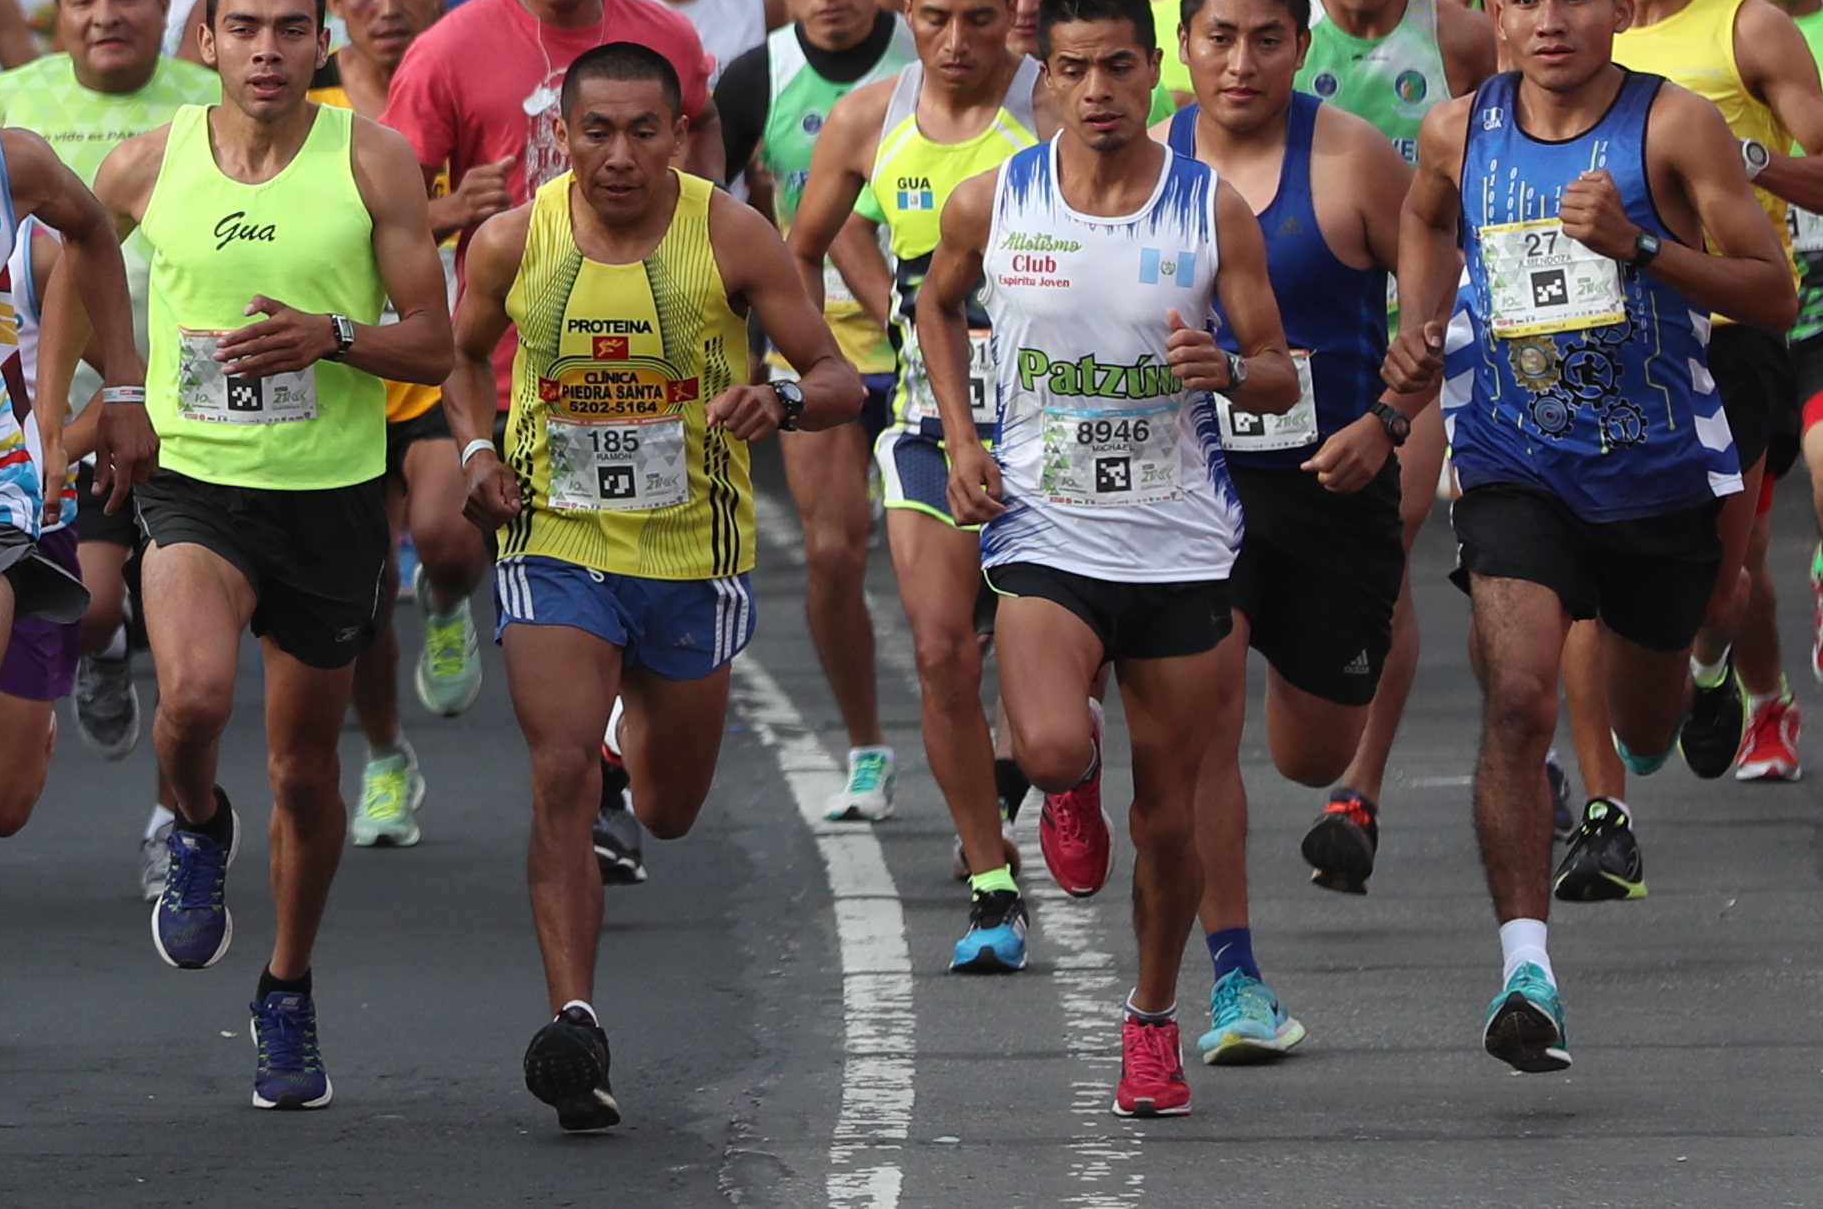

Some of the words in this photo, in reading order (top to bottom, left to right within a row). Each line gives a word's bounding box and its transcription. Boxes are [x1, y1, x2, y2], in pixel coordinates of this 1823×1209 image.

[897, 177, 931, 189] GUA
[214, 211, 276, 251] Gua
[1524, 231, 1558, 258] 27
[1012, 254, 1057, 274] Club
[1039, 277, 1070, 288] Joven
[567, 319, 654, 334] PROTEINA
[584, 370, 639, 385] CLÍNICA
[1018, 347, 1183, 399] Patzún
[561, 385, 612, 400] PIEDRA
[616, 385, 664, 400] SANTA
[569, 400, 658, 414] 5202-5164
[1077, 419, 1150, 445] 8946
[587, 430, 640, 453] 185
[1091, 442, 1134, 452] MICHAEL
[596, 453, 632, 461] RAMON
